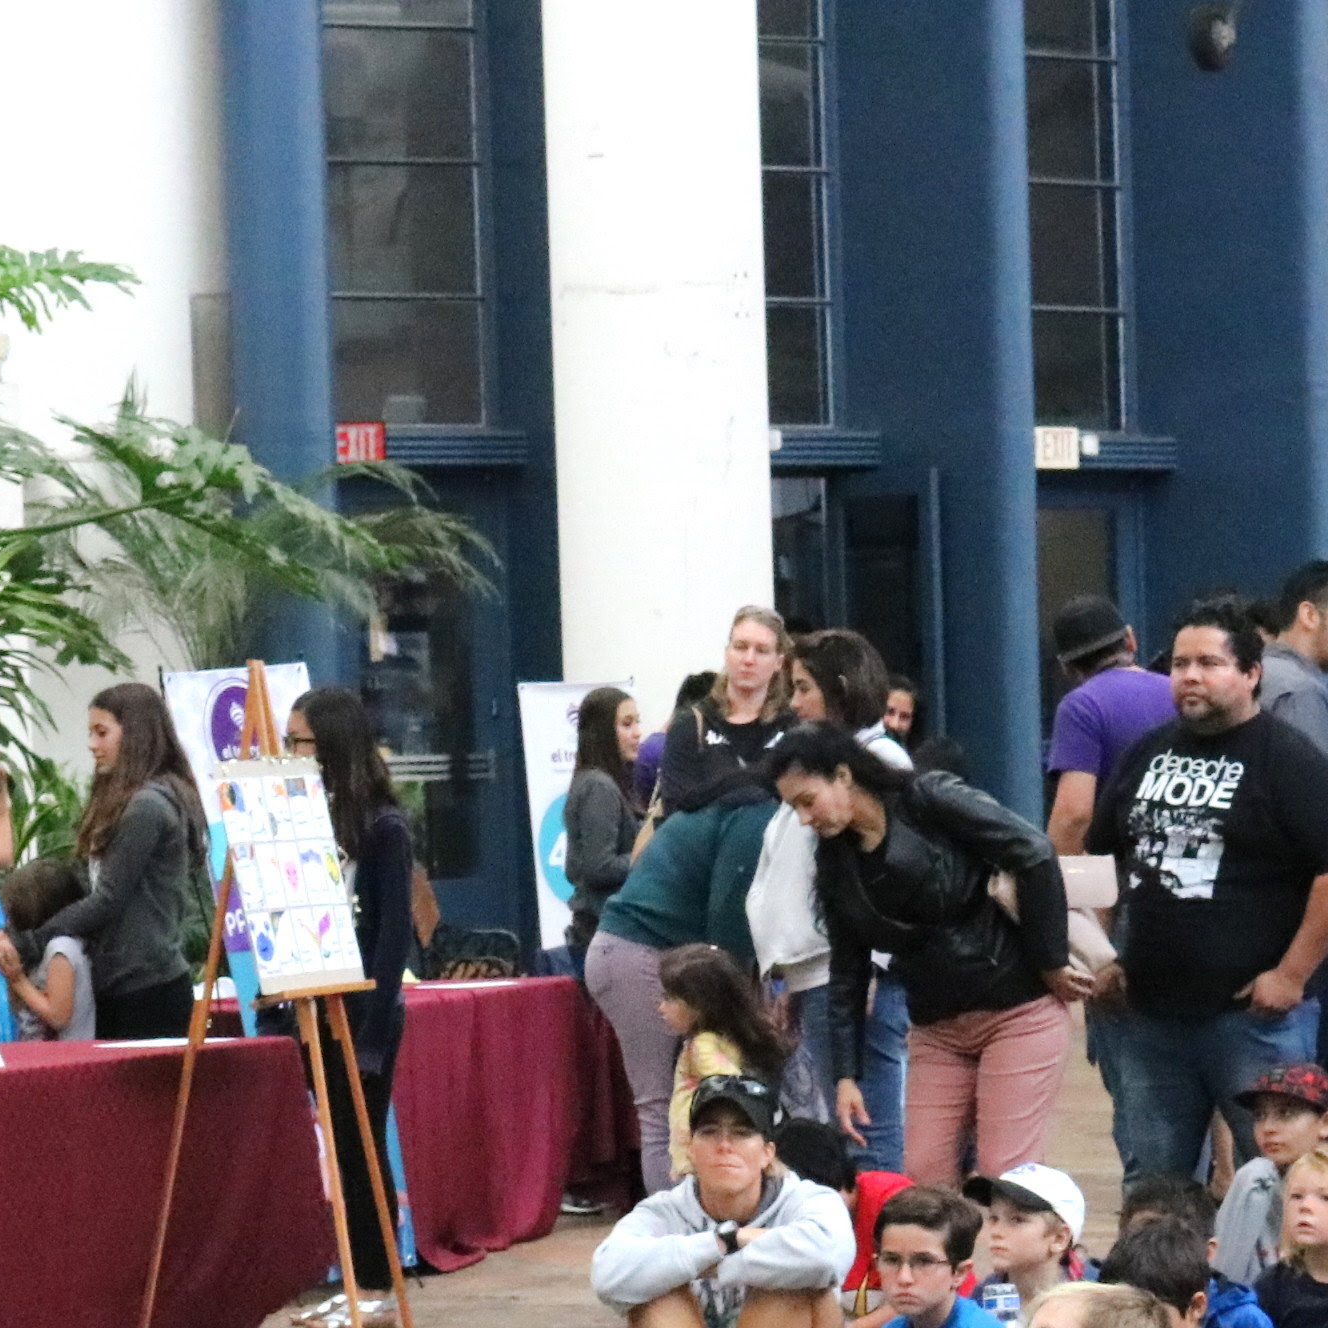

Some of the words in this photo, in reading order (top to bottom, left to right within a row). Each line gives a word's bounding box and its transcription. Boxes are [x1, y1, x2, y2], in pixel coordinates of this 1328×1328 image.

[335, 427, 377, 462] EXIT
[1149, 748, 1245, 783] depeche
[1135, 771, 1239, 810] MODE
